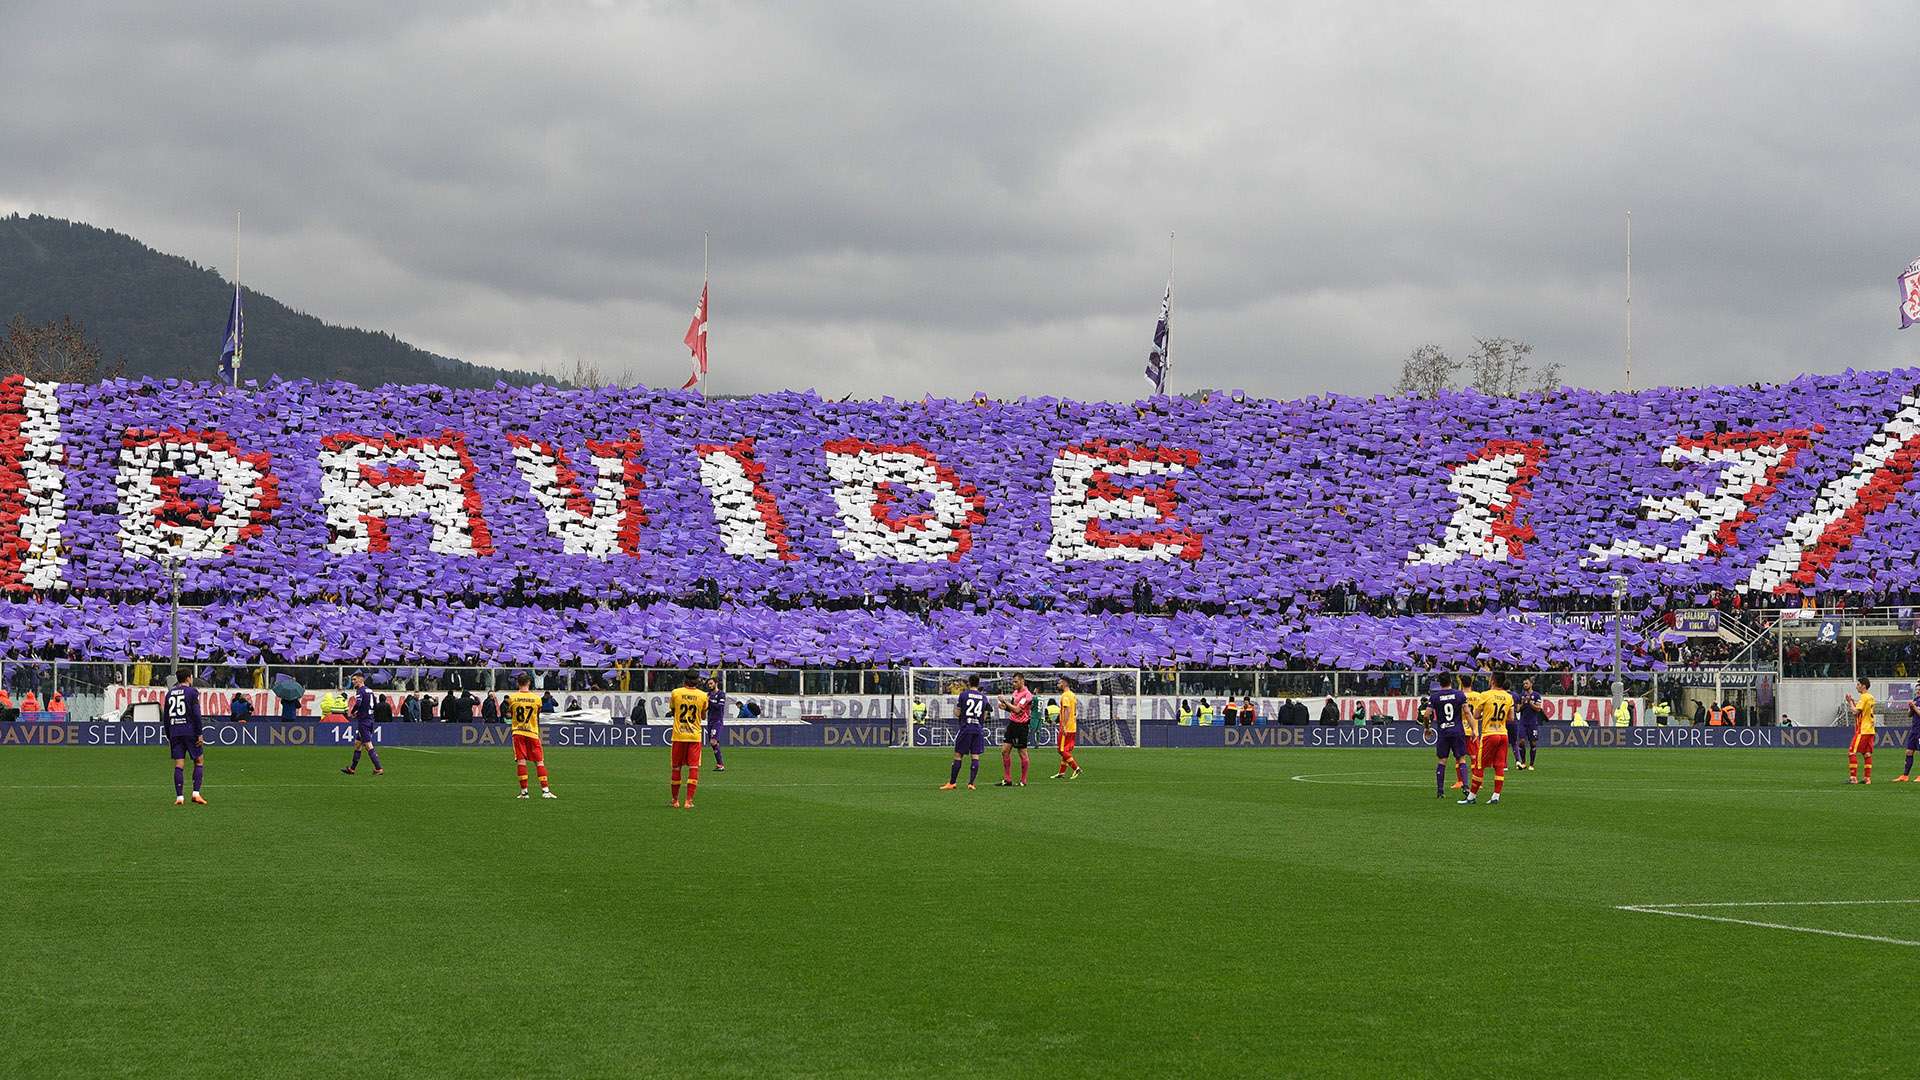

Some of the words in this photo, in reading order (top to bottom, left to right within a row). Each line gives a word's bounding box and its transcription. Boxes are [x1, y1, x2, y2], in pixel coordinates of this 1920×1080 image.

[114, 425, 1204, 564] DAVIDE
[168, 695, 187, 717] 25
[516, 705, 534, 723] 87
[679, 703, 697, 724] 23
[965, 699, 983, 717] 24
[1443, 702, 1455, 722] 9
[1490, 702, 1506, 722] 16
[0, 725, 79, 744] AVIDE
[269, 726, 314, 745] NOI
[461, 726, 550, 745] DAVE
[558, 727, 652, 746] SEMPRE
[728, 728, 772, 746] NOI
[1224, 728, 1305, 746] DAVIDE
[1312, 728, 1396, 746] SEMPRE
[1405, 728, 1439, 746] CO
[1550, 728, 1627, 746] DAVIDE
[1633, 728, 1714, 747] SEMPRE
[1722, 729, 1772, 747] CON
[1780, 729, 1819, 747] NOI
